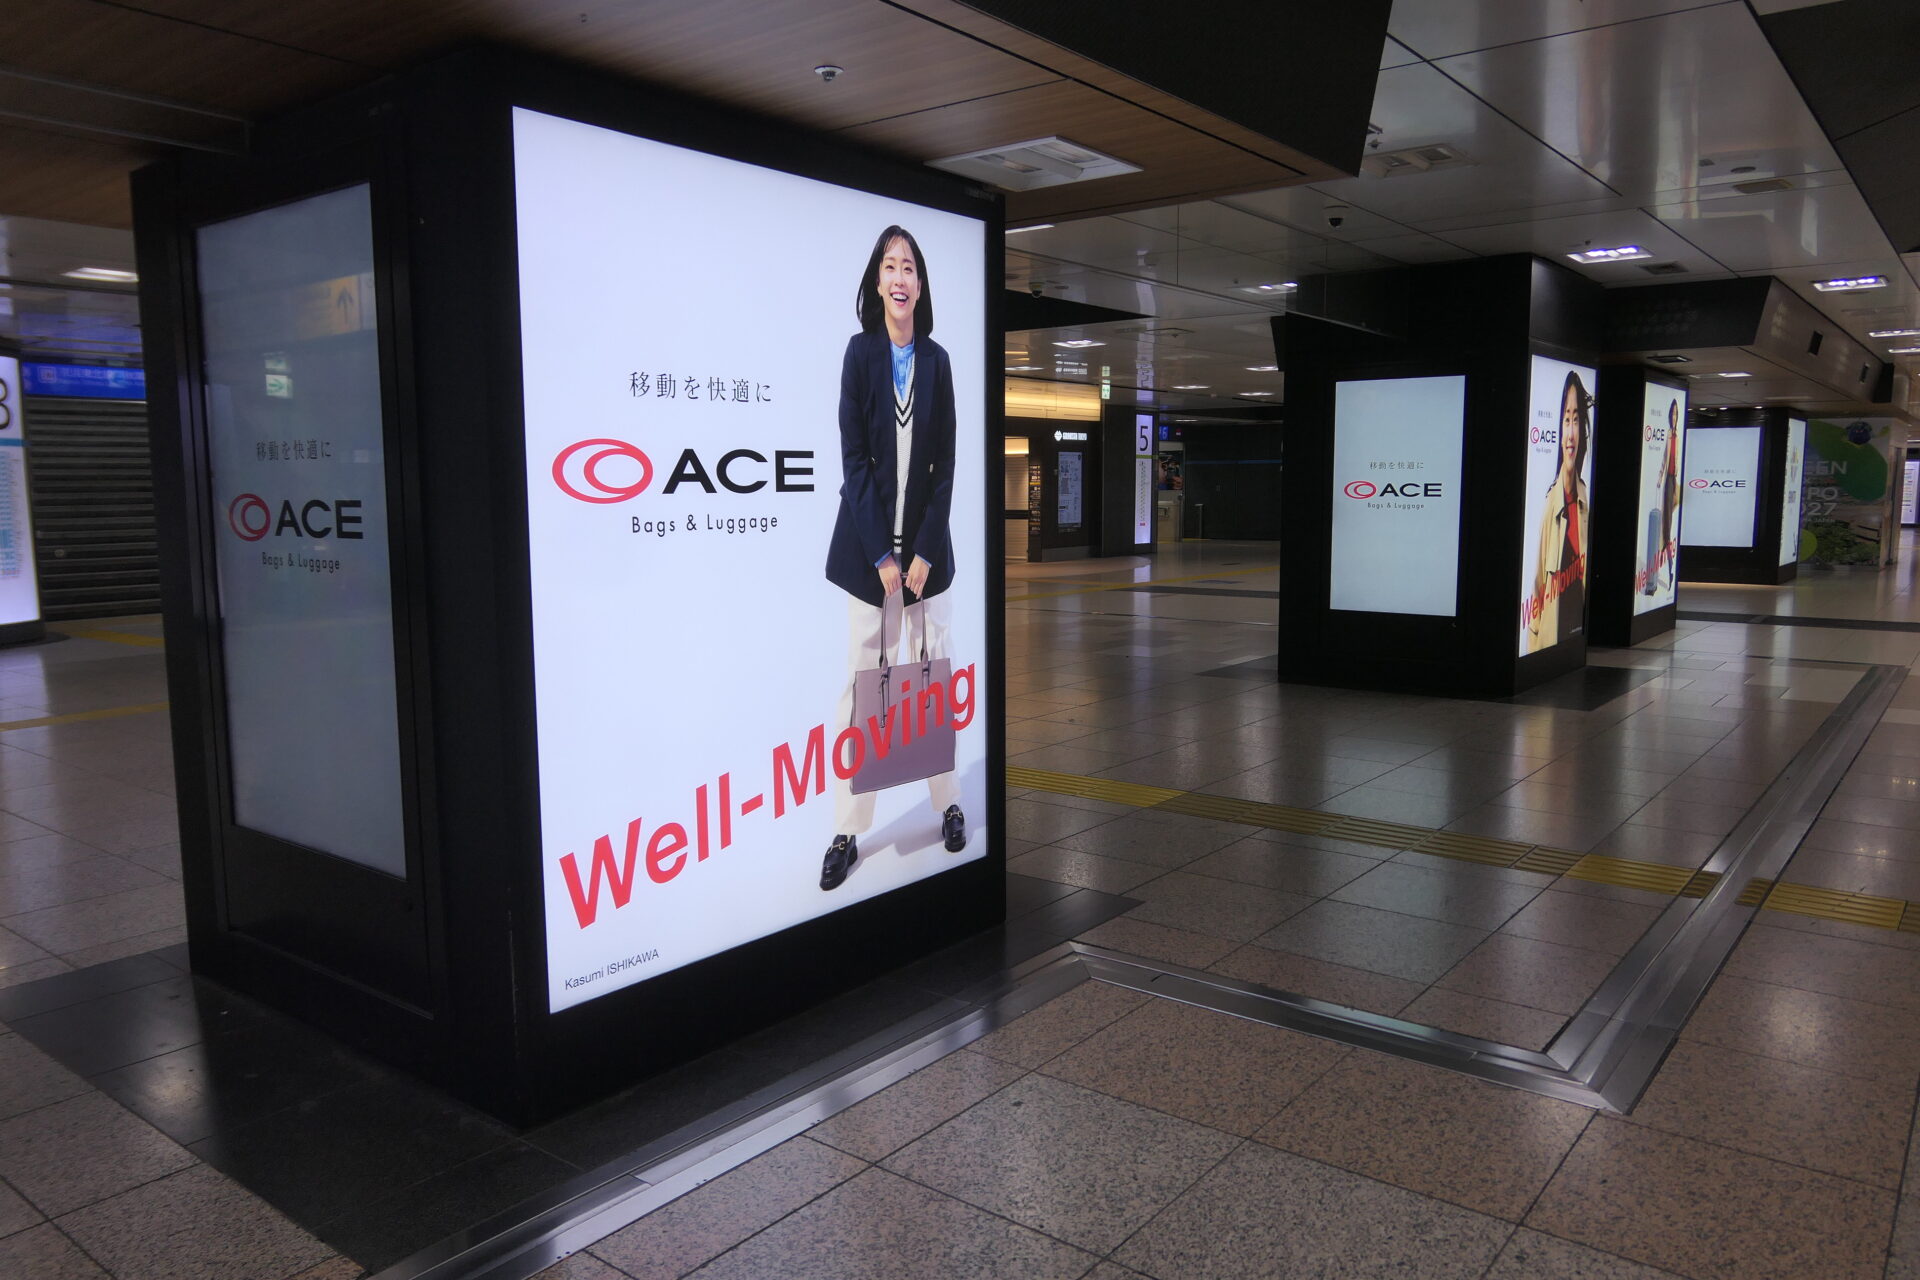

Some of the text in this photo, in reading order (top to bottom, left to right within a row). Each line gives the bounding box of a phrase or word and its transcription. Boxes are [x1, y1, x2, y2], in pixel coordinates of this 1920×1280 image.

[629, 371, 772, 403] 移動を快適に
[1139, 425, 1149, 451] 5
[1540, 430, 1557, 444] ACE
[1652, 428, 1666, 442] ACE
[256, 439, 332, 461] 移動を快適に
[662, 448, 815, 494] ACE
[1379, 483, 1443, 497] ACE
[1709, 480, 1747, 488] ACE
[275, 499, 364, 540] ACE
[632, 513, 779, 538] Bags & Luggage
[262, 551, 340, 574] Bags & Luggage
[559, 663, 976, 930] Well-Moving
[565, 948, 660, 990] Kasumi ISHIKAWA
